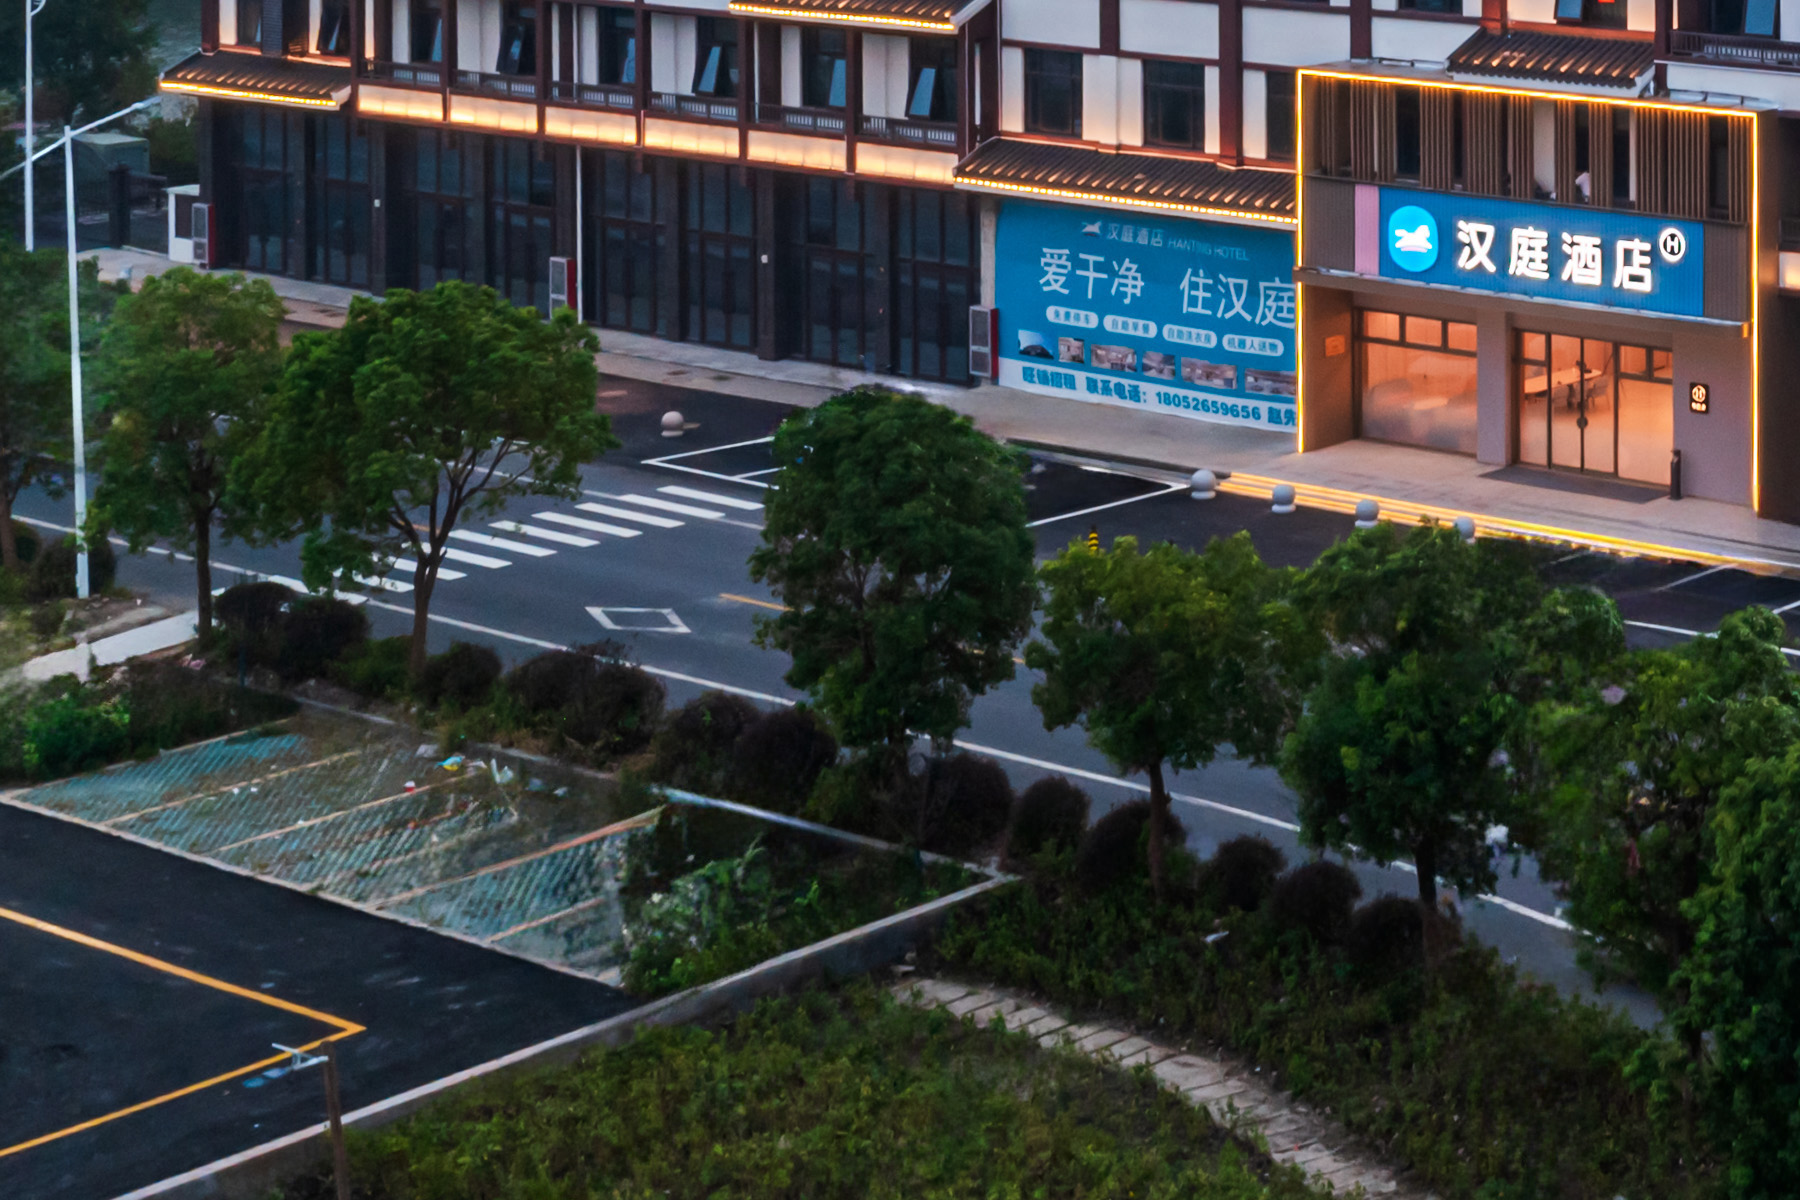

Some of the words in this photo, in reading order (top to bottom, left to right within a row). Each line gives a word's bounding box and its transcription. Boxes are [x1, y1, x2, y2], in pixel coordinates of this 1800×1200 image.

[1107, 222, 1164, 247] 汉庭酒店
[1167, 236, 1212, 256] HANTING
[1214, 245, 1249, 261] HOTEL
[1458, 220, 1653, 292] 汉庭酒店
[1039, 248, 1144, 304] 爱干净
[1180, 268, 1295, 329] 住汉庭
[1022, 366, 1076, 390] 旺铺招租
[1155, 391, 1261, 420] 18052659656
